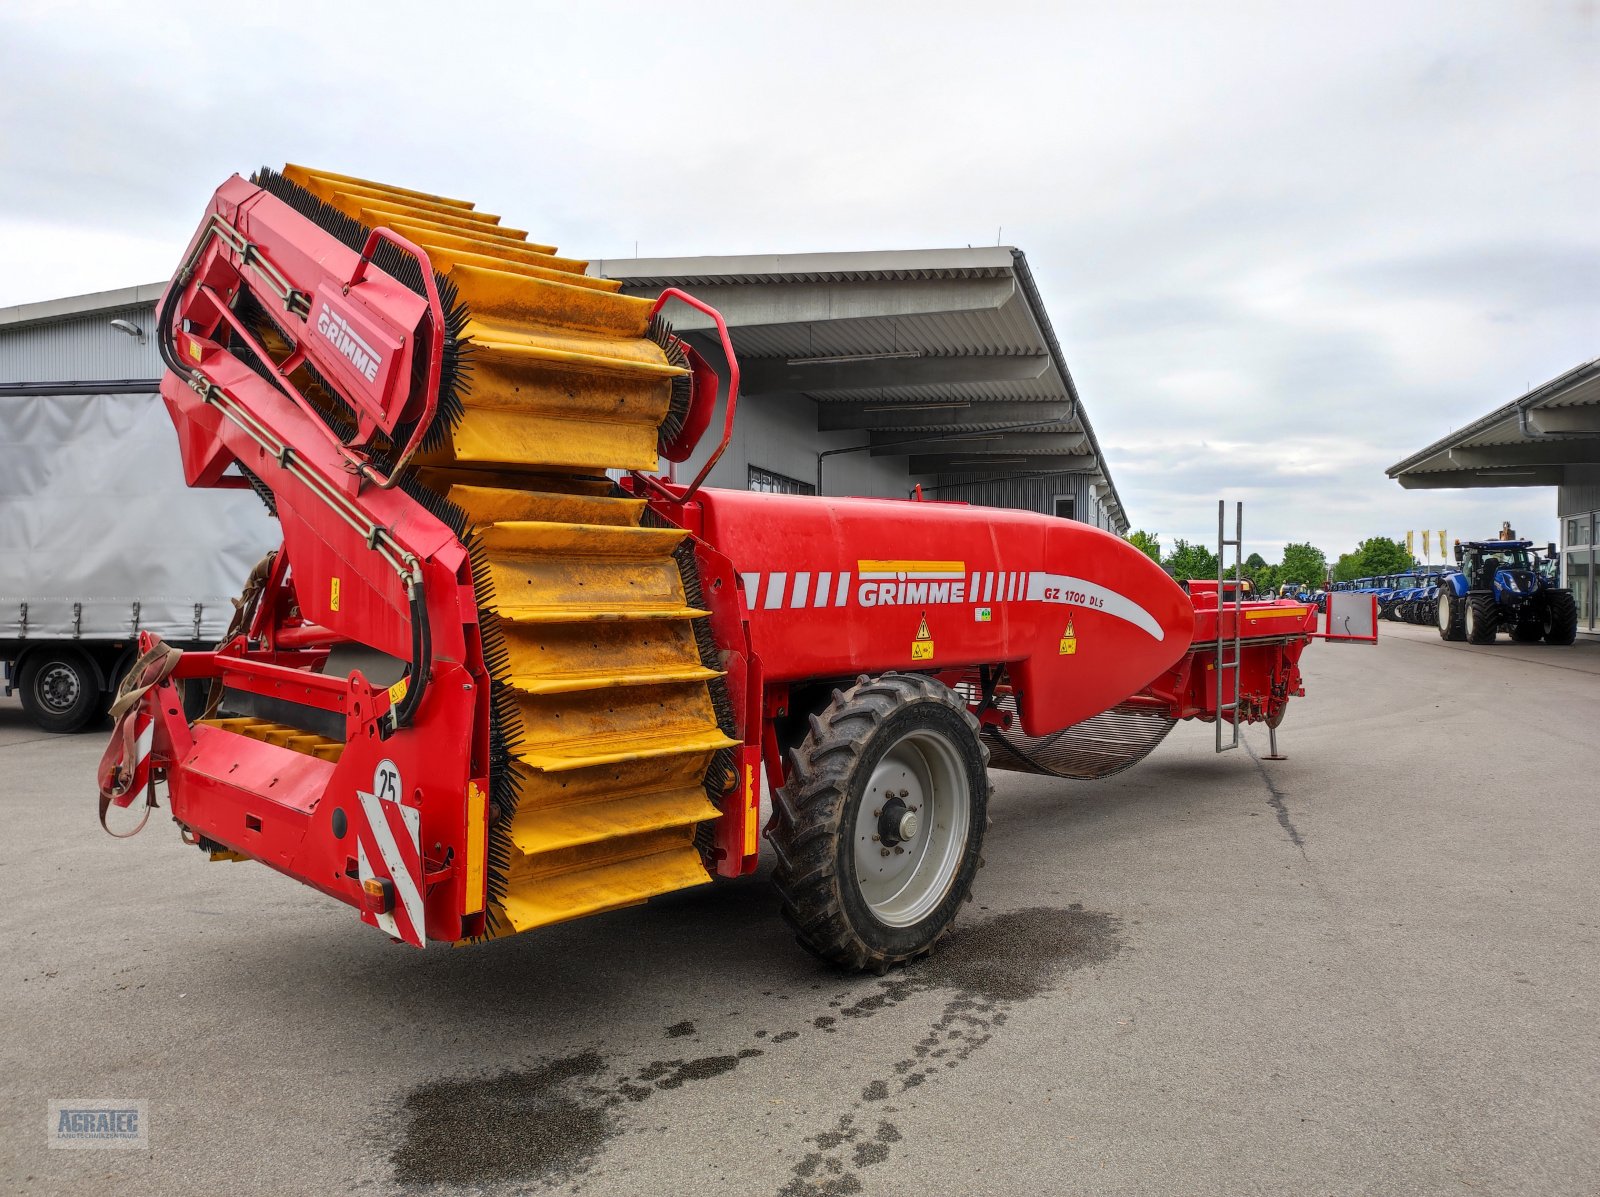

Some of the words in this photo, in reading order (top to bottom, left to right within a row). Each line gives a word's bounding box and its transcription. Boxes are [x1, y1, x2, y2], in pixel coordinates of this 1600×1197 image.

[317, 310, 380, 384] GRIMME
[858, 578, 965, 607] GRIMME
[1044, 587, 1060, 600] GZ
[1065, 590, 1086, 604] 1700
[1089, 595, 1104, 608] DLS
[380, 768, 397, 802] 25
